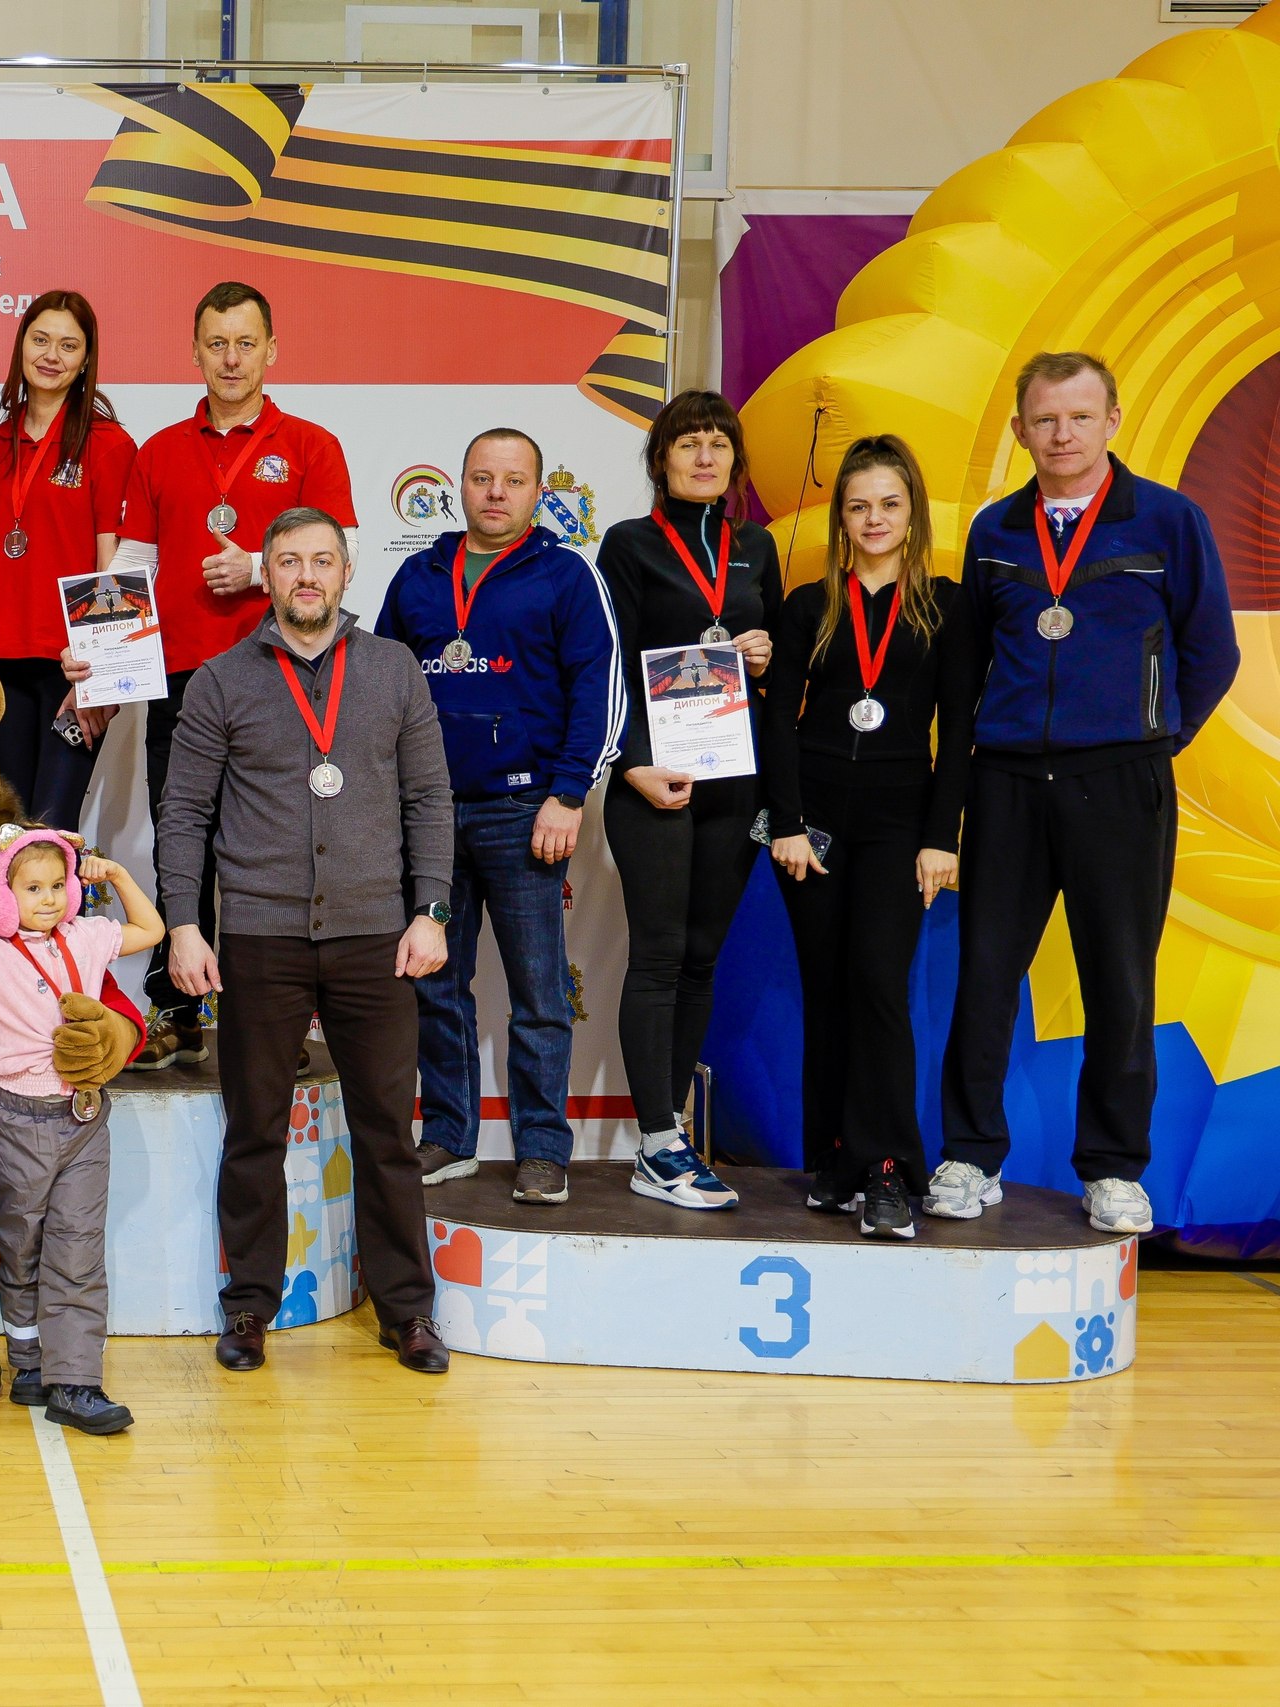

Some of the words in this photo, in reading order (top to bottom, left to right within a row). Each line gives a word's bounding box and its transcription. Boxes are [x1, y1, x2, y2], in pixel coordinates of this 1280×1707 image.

[91, 621, 134, 635] ДИПЛОМ
[421, 654, 488, 674] adas
[673, 696, 720, 710] ДИПЛОМ
[739, 1255, 812, 1359] 3
